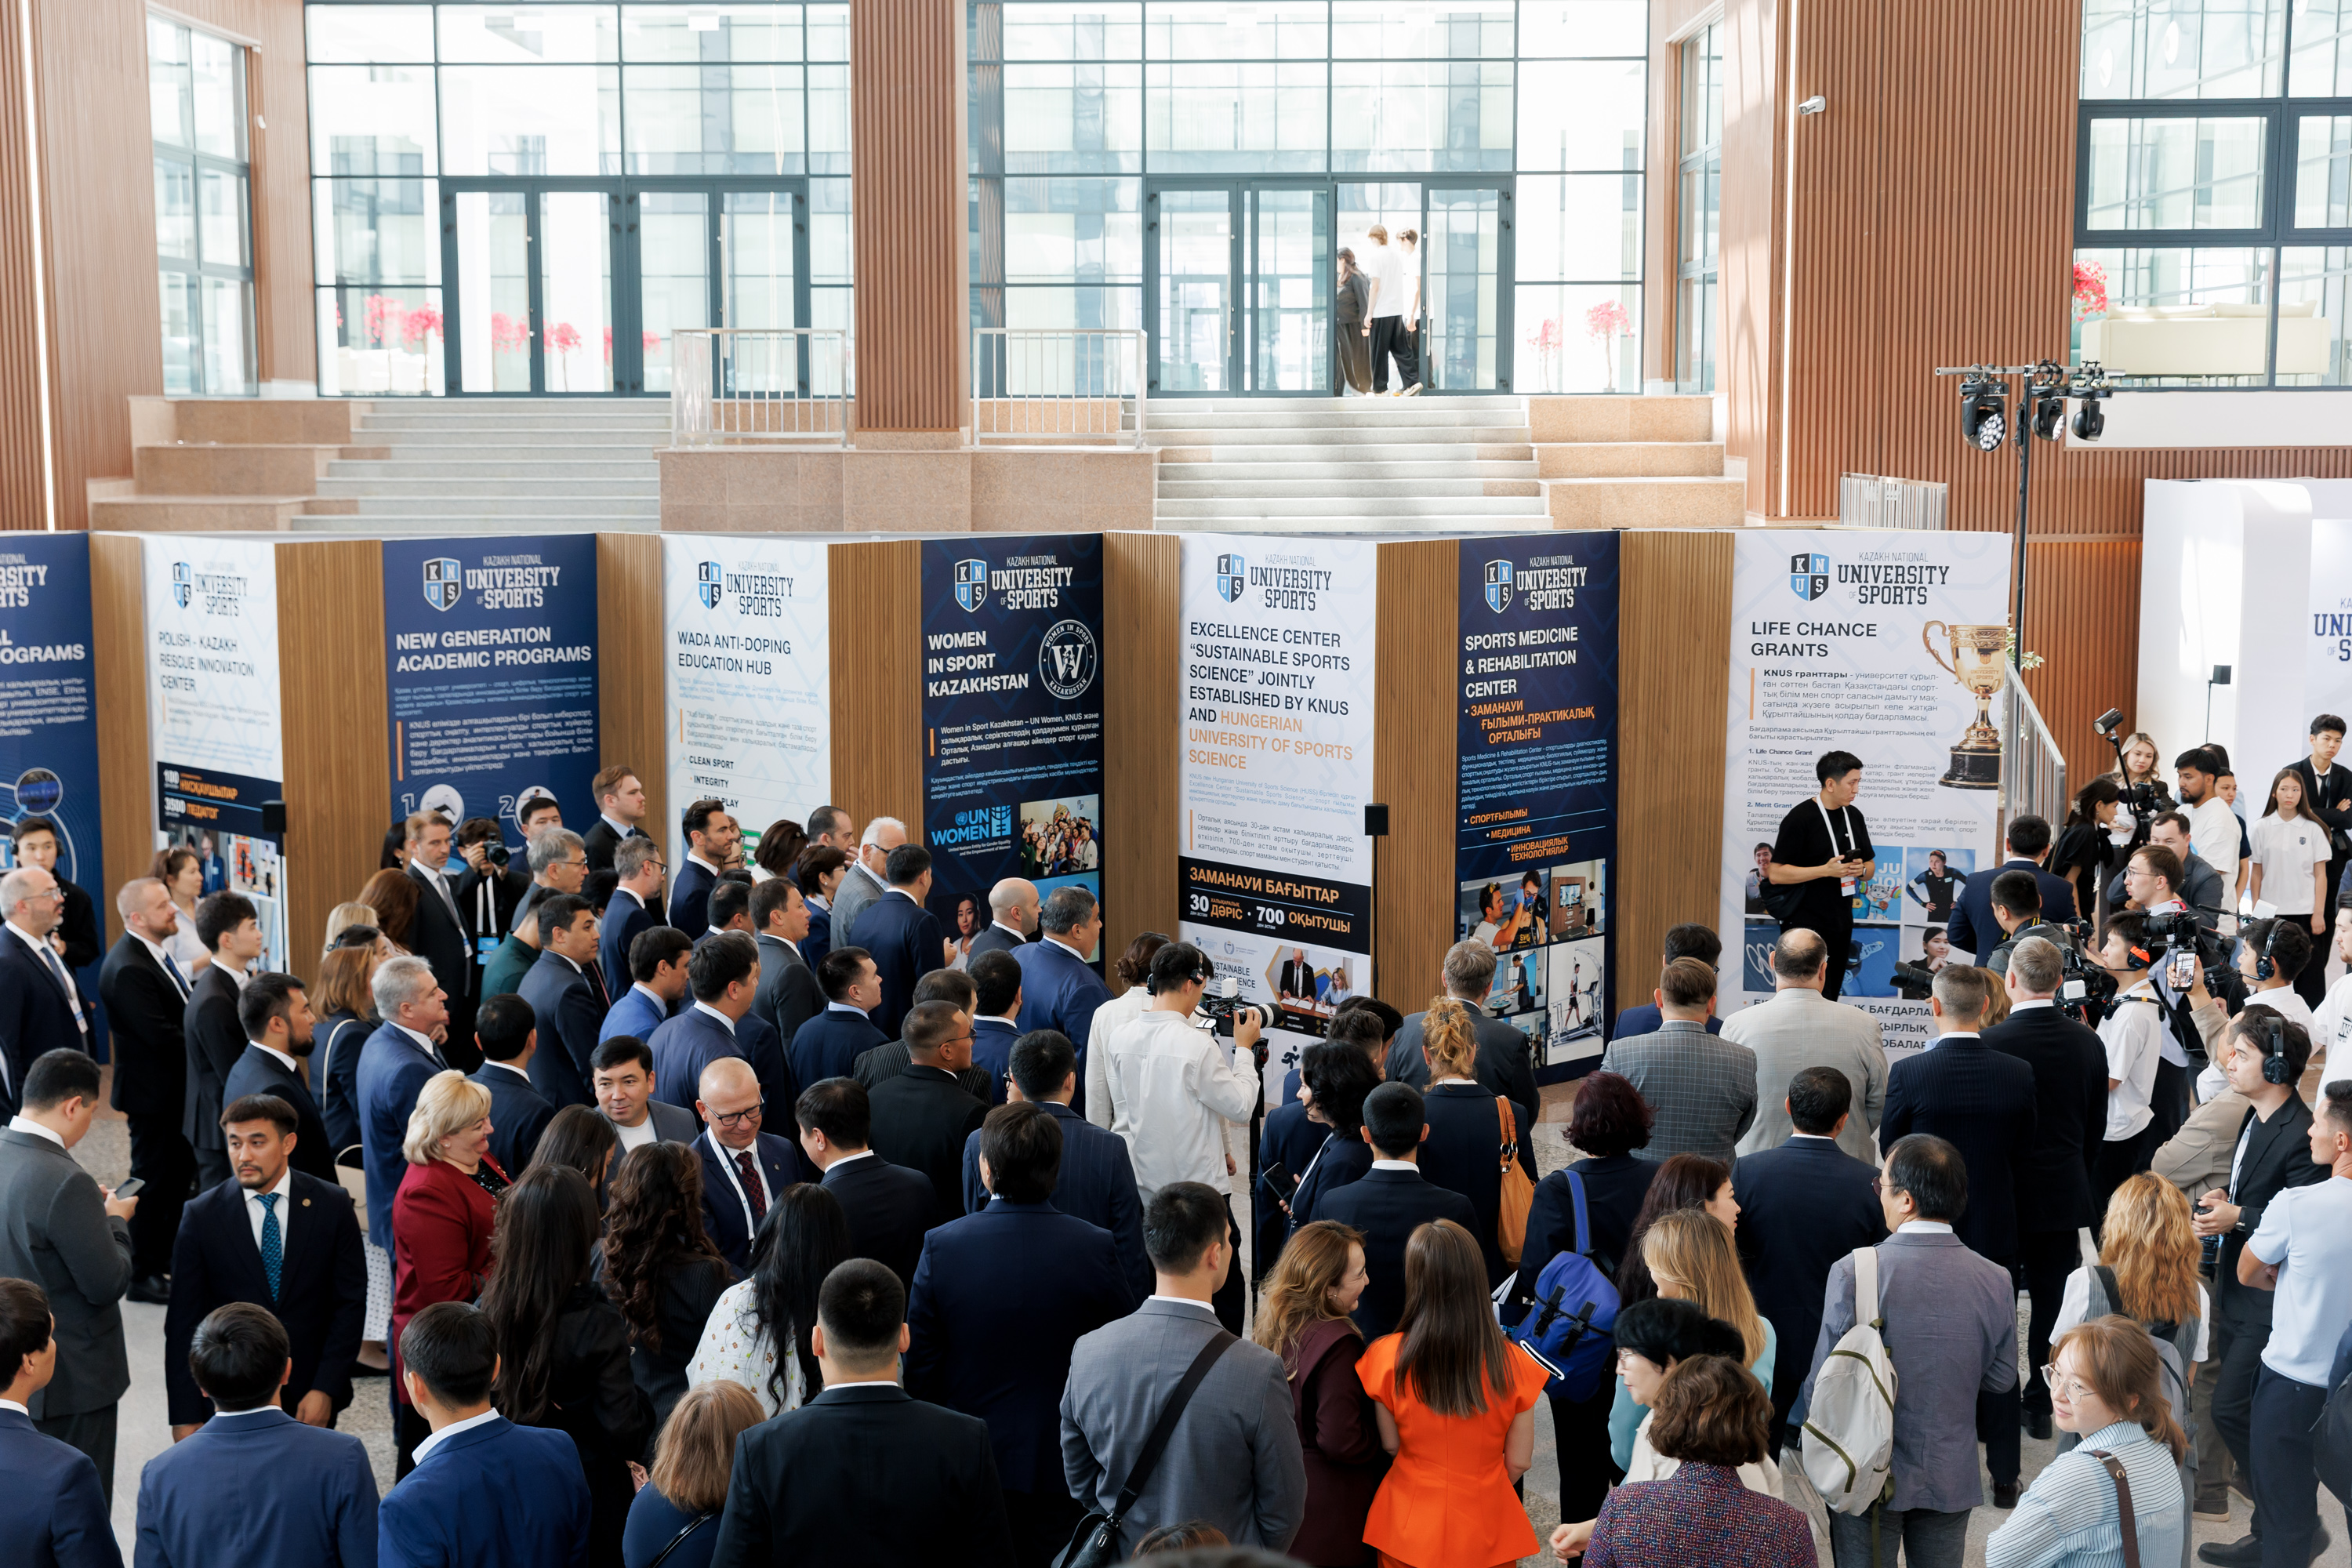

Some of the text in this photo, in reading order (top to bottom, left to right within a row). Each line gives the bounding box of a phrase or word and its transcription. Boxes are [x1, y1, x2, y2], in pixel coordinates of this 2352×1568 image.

[1007, 555, 1058, 567] KAZAKH NATIONAL
[1265, 554, 1316, 567] KAZAKH NATIONAL
[1530, 555, 1574, 568] KAZAKH NATIONAL
[1858, 551, 1929, 562] KAZAKH NATIONAL
[465, 566, 561, 590] UNIVERSITY
[991, 567, 1073, 590] UNIVERSITY
[1250, 566, 1332, 590] UNIVERSITY
[1516, 567, 1587, 590] UNIVERSITY
[1838, 564, 1950, 585] UNIVERSITY
[726, 574, 793, 597] UNIVERSITY
[1849, 585, 1927, 604] OF SPORTS
[484, 587, 543, 609] SPORTS
[739, 596, 782, 617] SPORTS
[1000, 588, 1058, 610] OF SPORTS
[1265, 589, 1316, 611] SPORTS
[1524, 589, 1574, 610] OF SPORTS
[396, 627, 551, 650] NEW GENERATION
[1045, 626, 1065, 647] WOMEN
[1076, 626, 1091, 644] SPORT
[1190, 622, 1341, 647] EXCELLENCE CENTER
[1465, 626, 1578, 651] SPORTS MEDICINE
[1751, 622, 1877, 637] LIFE CHANCE
[158, 631, 237, 652] POLISH KAZAKH
[677, 631, 791, 654] WADA ANTI-DOPING
[927, 631, 986, 650] WOMEN
[1751, 643, 1828, 657] GRANTS
[159, 653, 254, 676] RESCUE INNOVATION
[396, 646, 592, 671] ACADEMIC PROGRAMS
[678, 653, 771, 675] EDUCATION HUB
[928, 653, 996, 673] IN SPORT
[1292, 652, 1350, 670] SPORTS
[1465, 650, 1576, 674] & REHABILITATION
[160, 675, 196, 691] CENTER
[928, 674, 1029, 696] KAZAKHSTAN
[1049, 678, 1087, 695] KAZAKHSTAN
[1258, 671, 1315, 689] JOINTLY
[1465, 679, 1517, 698] CENTER
[1845, 682, 1907, 691] Қазақстандағы
[1189, 686, 1348, 715] ESTABLISHED BY KNUS
[1471, 700, 1523, 716] ЗАМАНАУИ
[1884, 694, 1918, 702] дамыту
[1189, 707, 1303, 733] AND HUNGERIAN
[1481, 707, 1595, 729] ҒЫЛЫМИ-ПРАКТИКАЛЫҚ
[1762, 710, 1929, 721] Құрылтайшының қолдау бағдарламасы.
[940, 726, 964, 735] Women
[971, 722, 989, 731] Sport
[989, 720, 1024, 728] Kazakhstan
[941, 723, 1099, 745] халықаралық серіктестердің қолдауымен құрылған
[1488, 728, 1541, 743] ОРТАЛЫҒЫ
[941, 746, 970, 756] Орталық
[971, 742, 1001, 751] Азиядағы
[1002, 739, 1029, 748] алғашқы
[1189, 728, 1353, 760] UNIVERSITY OF SPORTS
[689, 756, 734, 769] CLEAN SPORT
[941, 757, 970, 767] дастығы.
[1189, 749, 1247, 769] SCIENCE
[694, 775, 729, 788] INTEGRITY
[721, 797, 739, 808] PLAY
[968, 808, 989, 825] UN
[931, 824, 989, 845] WOMEN
[1490, 826, 1531, 838] МЕДИЦИНА
[1510, 845, 1569, 861] ТЕХНОЛОГИЯЛАР
[1189, 867, 1339, 902] ЗАМАНАУИ БАҒЫТТАР
[1190, 894, 1350, 933] 30 ДӘРІС 700 ОҚЫТУШЫ
[1212, 963, 1250, 976] USTAINABLE
[1869, 1005, 1933, 1016] БАҒДАРЛА
[1882, 1039, 1926, 1049] ОБАЛАР
